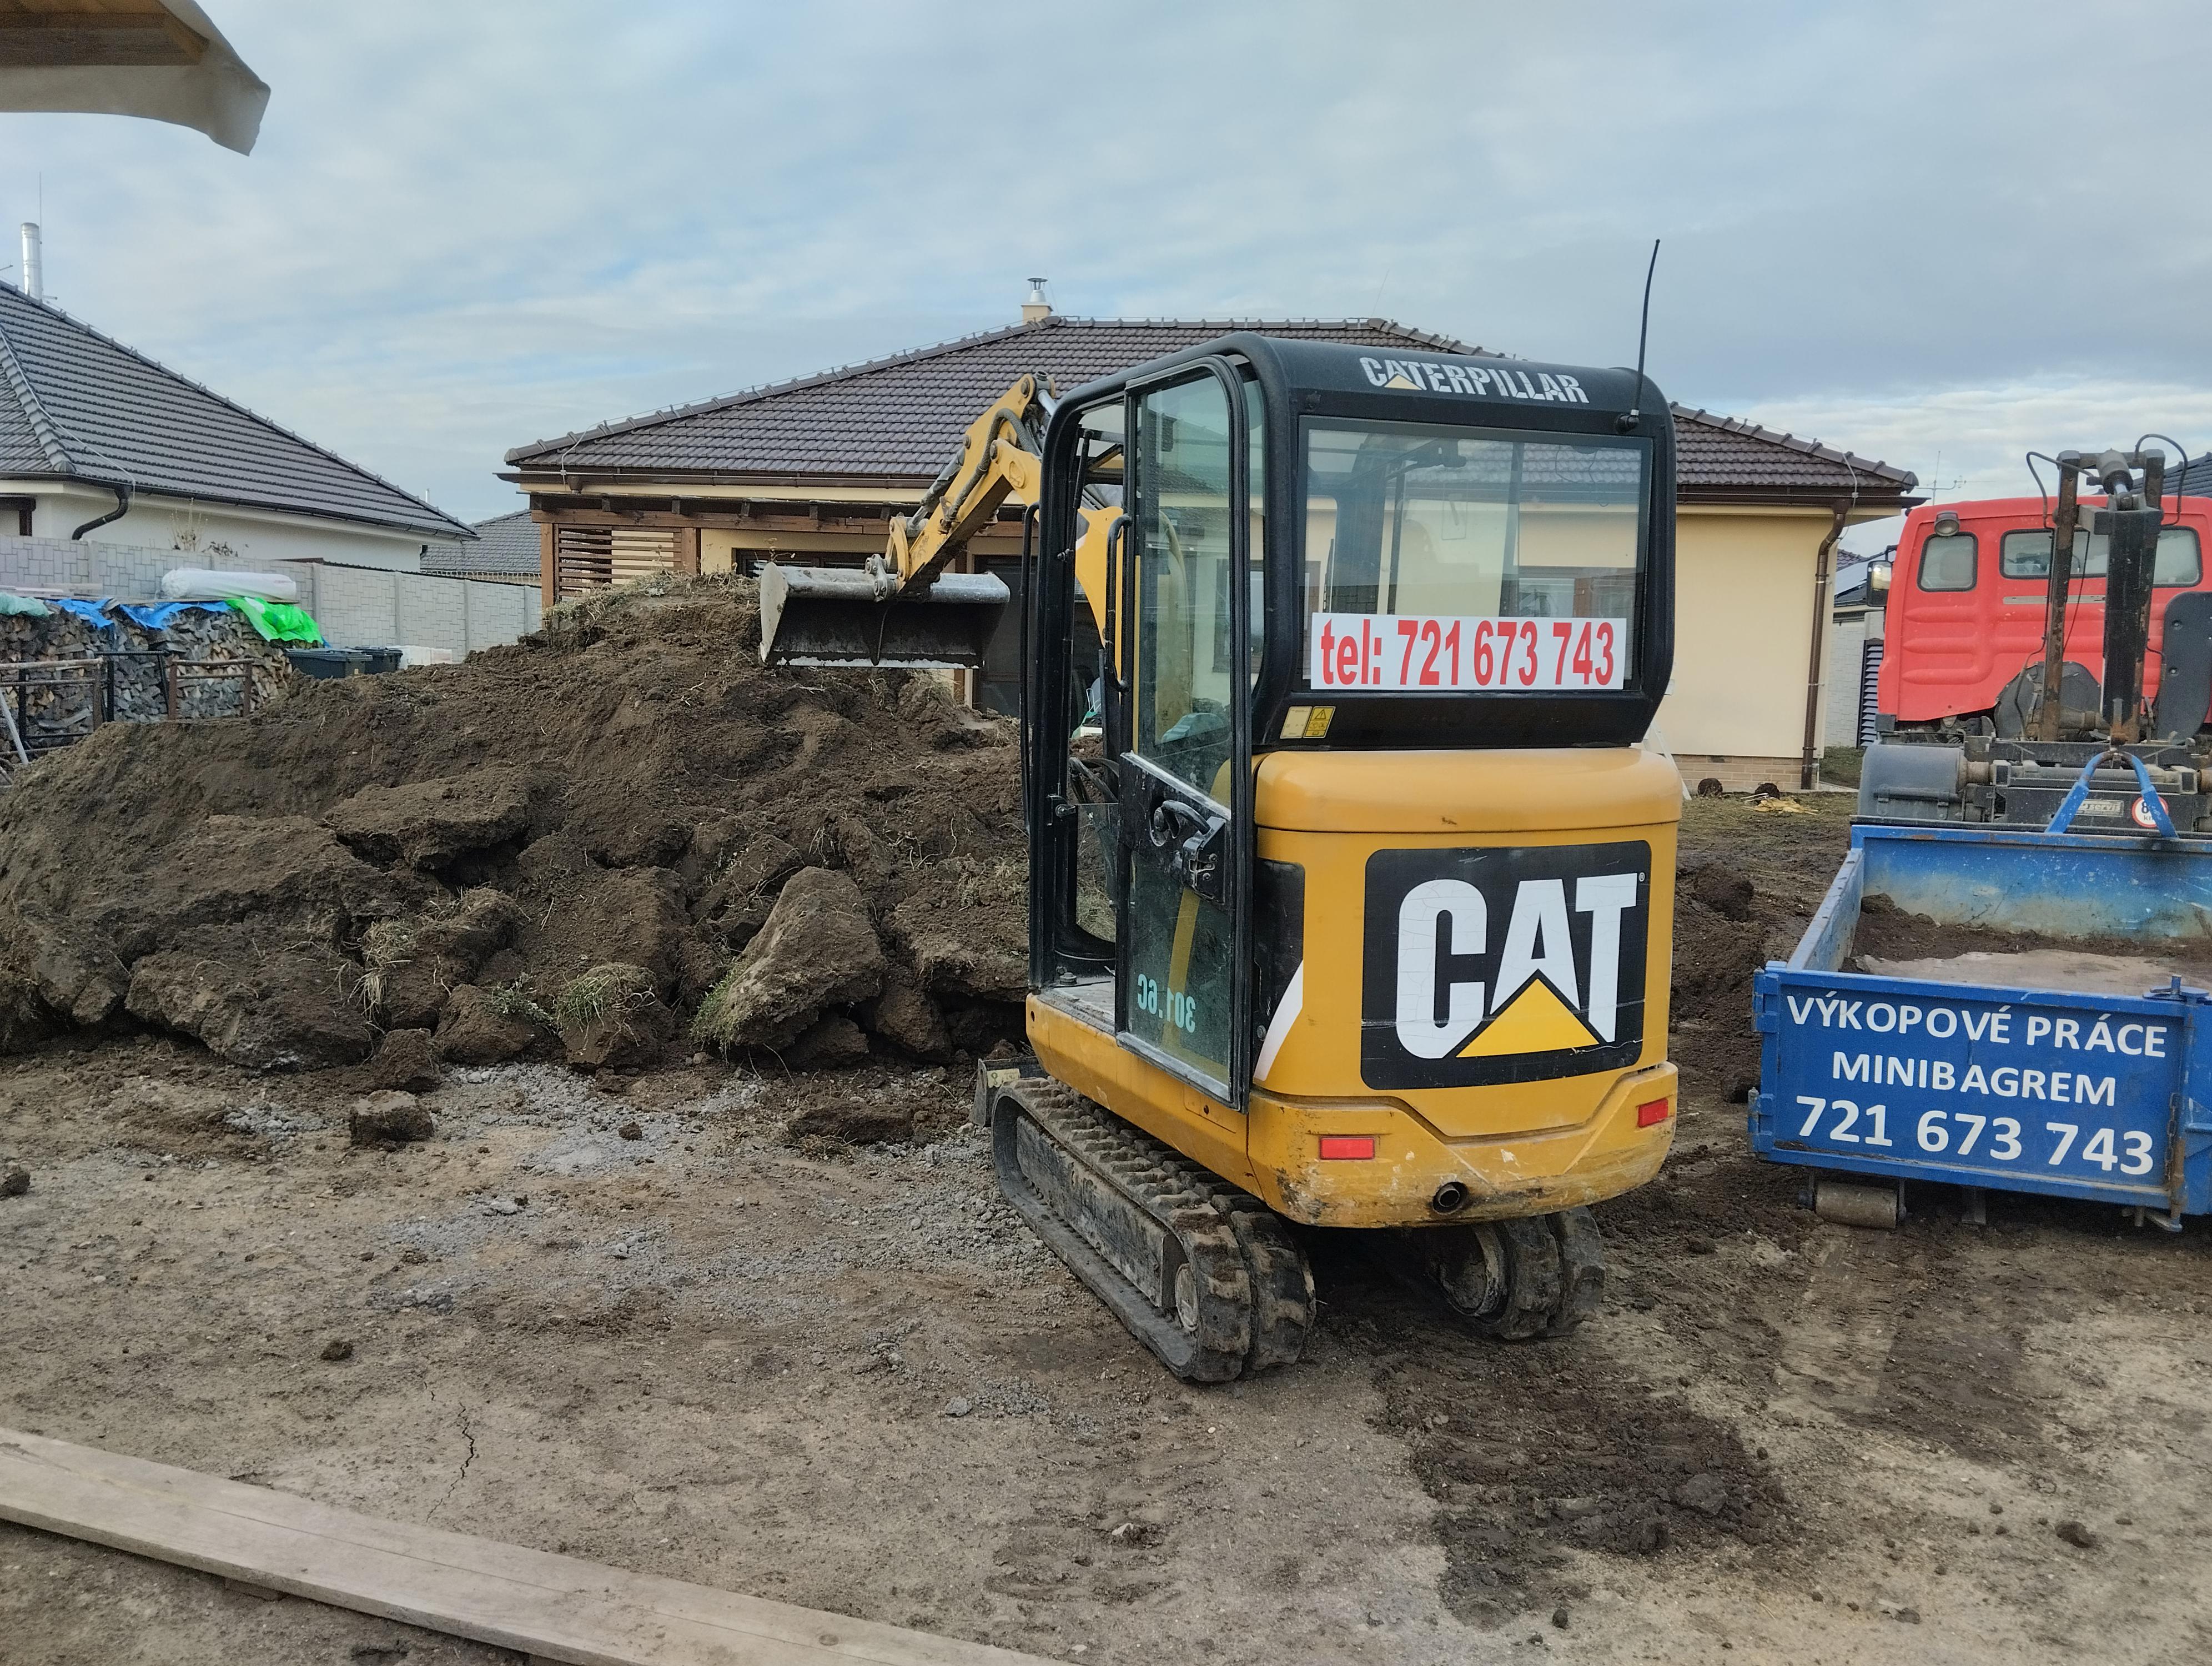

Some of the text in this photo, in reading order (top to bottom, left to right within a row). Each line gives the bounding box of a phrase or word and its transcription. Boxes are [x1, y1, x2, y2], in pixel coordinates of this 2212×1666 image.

[1359, 357, 1589, 403] CATERPILLAR
[1320, 619, 1613, 686] tel: 721 673 743
[1394, 873, 1637, 1059] CAT
[1787, 991, 2168, 1057] VÝKOPOVÉ PRÁCE
[1832, 1051, 2115, 1106] MINIBAGREM
[1796, 1095, 2153, 1175] 721 673 743
